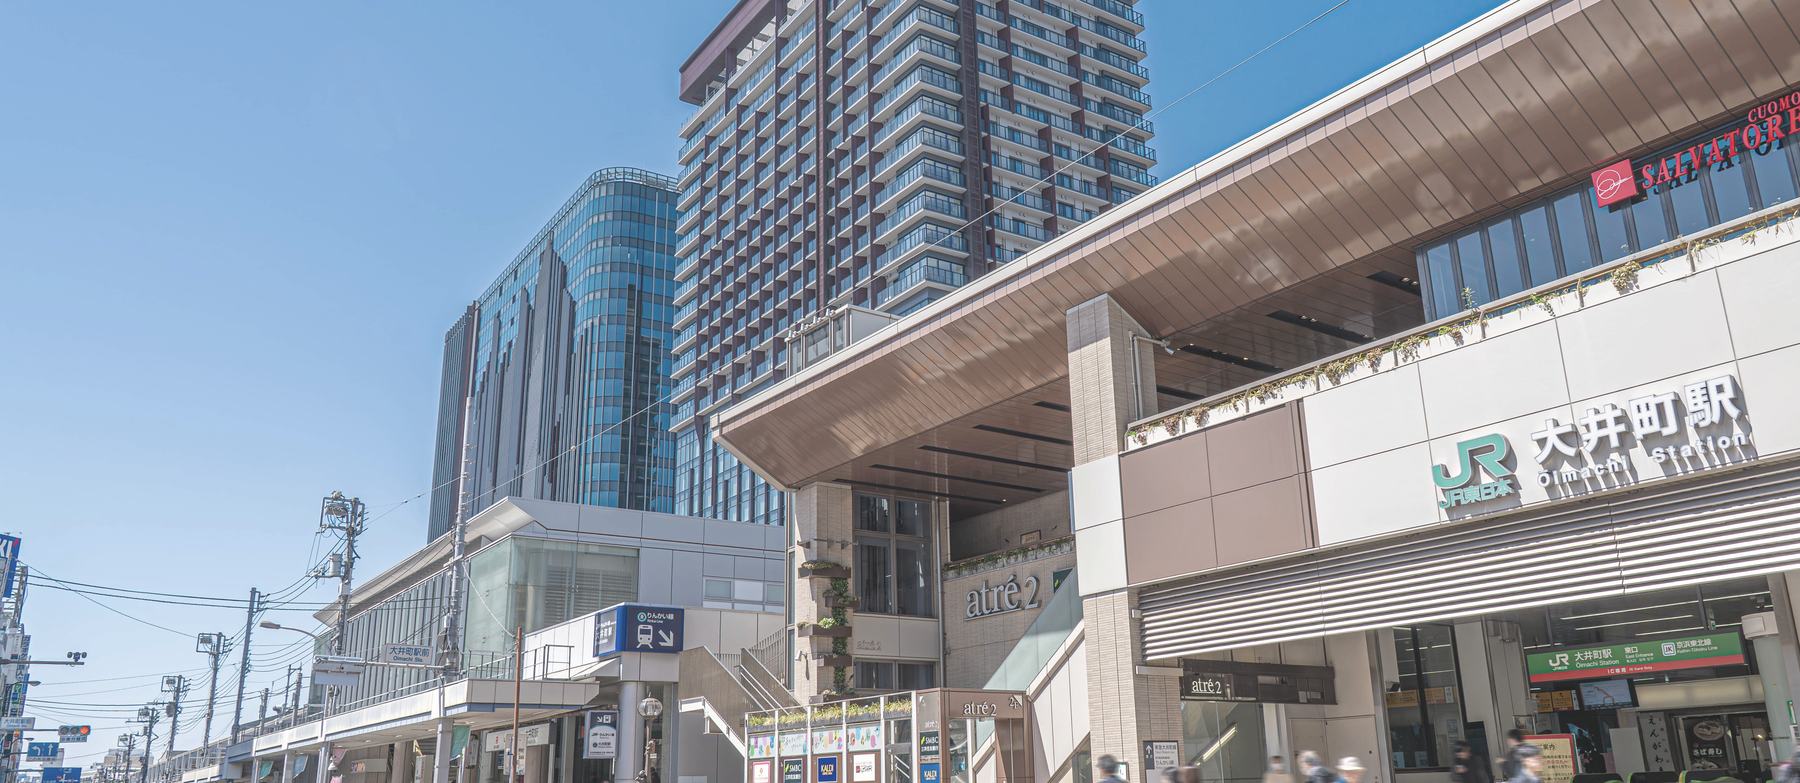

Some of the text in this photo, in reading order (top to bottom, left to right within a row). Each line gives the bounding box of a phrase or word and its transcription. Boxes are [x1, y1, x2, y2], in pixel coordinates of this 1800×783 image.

[1748, 91, 1800, 123] CUOMO
[1641, 106, 1800, 190] SALVATORE
[1531, 375, 1743, 464] 大井町駅
[1652, 431, 1748, 464] Station
[1432, 433, 1513, 489] JR
[1439, 479, 1515, 509] JR東日本
[965, 575, 1040, 619] atré 2
[647, 612, 674, 620] りんかい線
[1676, 639, 1712, 649] 京浜東北線
[389, 647, 430, 657] 大井町駅前
[1574, 648, 1613, 662] 大井町駅
[1549, 654, 1570, 667] JR
[1599, 659, 1620, 667] Station
[1192, 678, 1222, 694] atré 2
[964, 701, 998, 717] atré 2
[926, 736, 939, 744] SMBC
[789, 764, 801, 772] SMBC
[821, 764, 834, 772] KALDI
